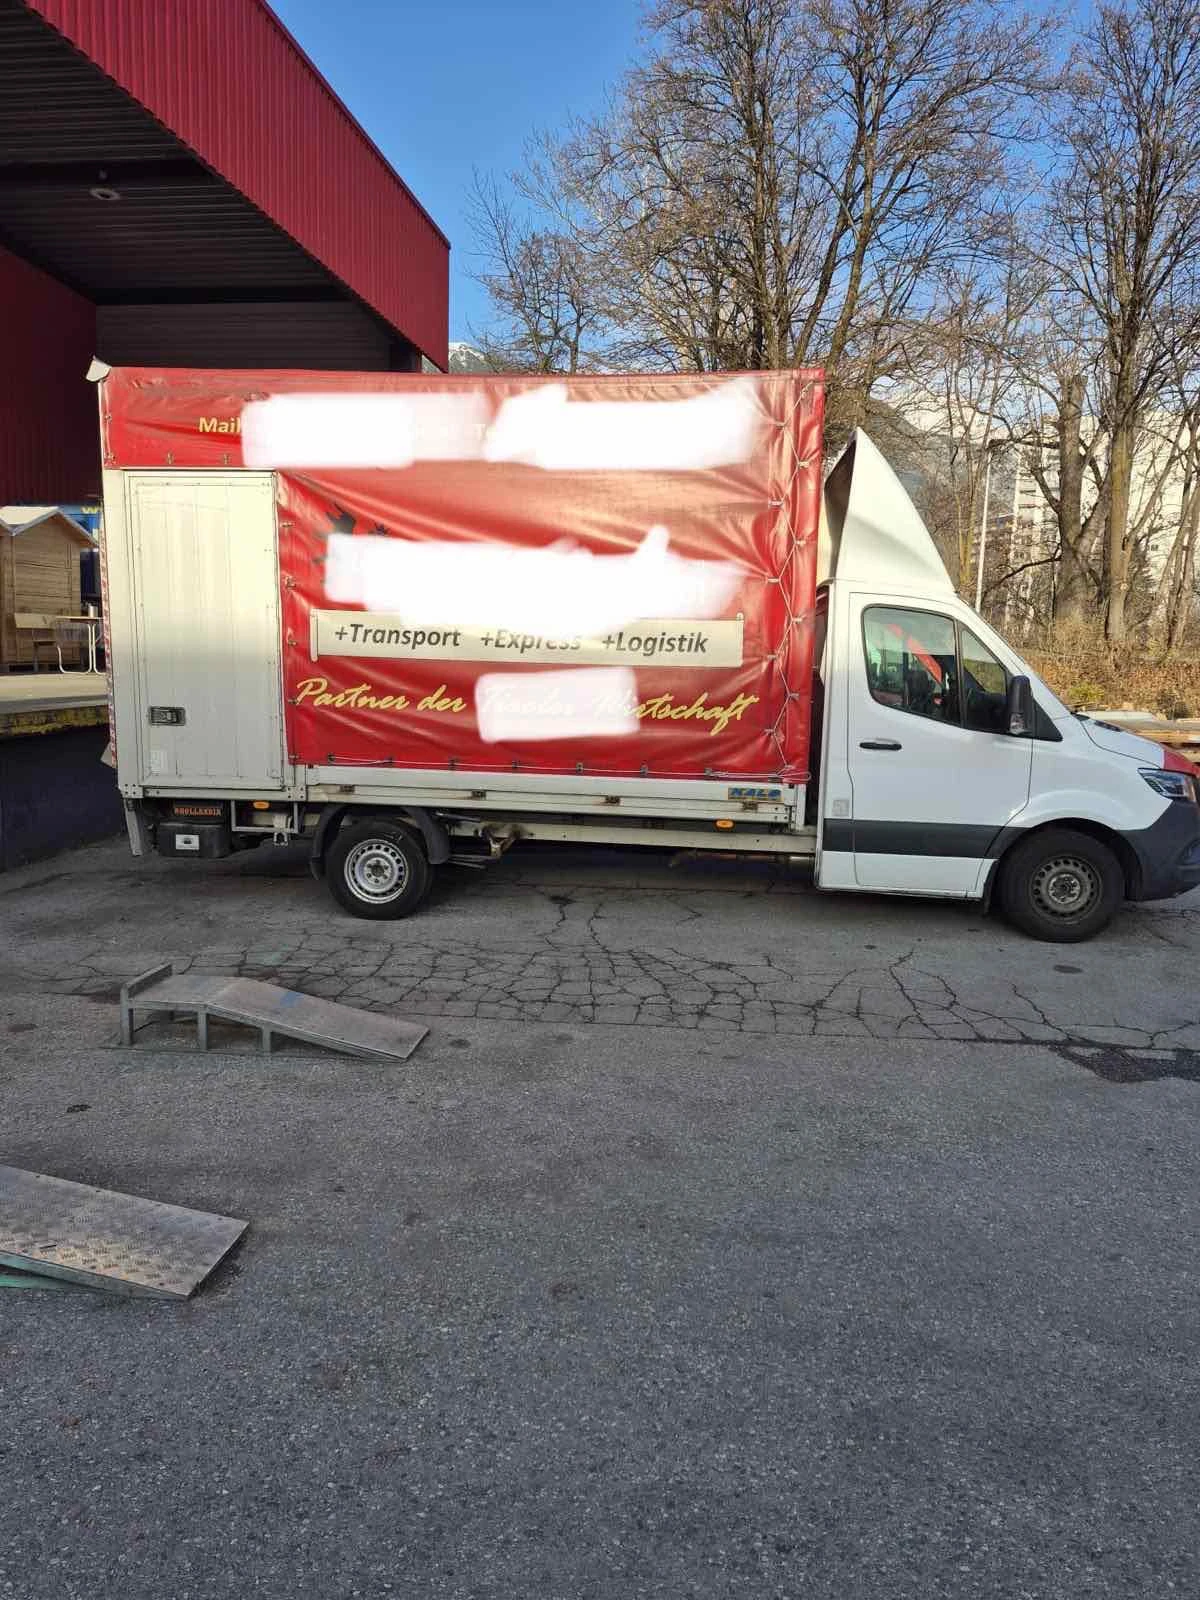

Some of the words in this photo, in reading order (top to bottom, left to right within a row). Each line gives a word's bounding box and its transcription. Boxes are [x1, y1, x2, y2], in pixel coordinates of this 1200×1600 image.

[334, 623, 461, 649] +Transport
[602, 632, 708, 656] +Logistik
[296, 677, 410, 711] Partner
[416, 684, 467, 713] der
